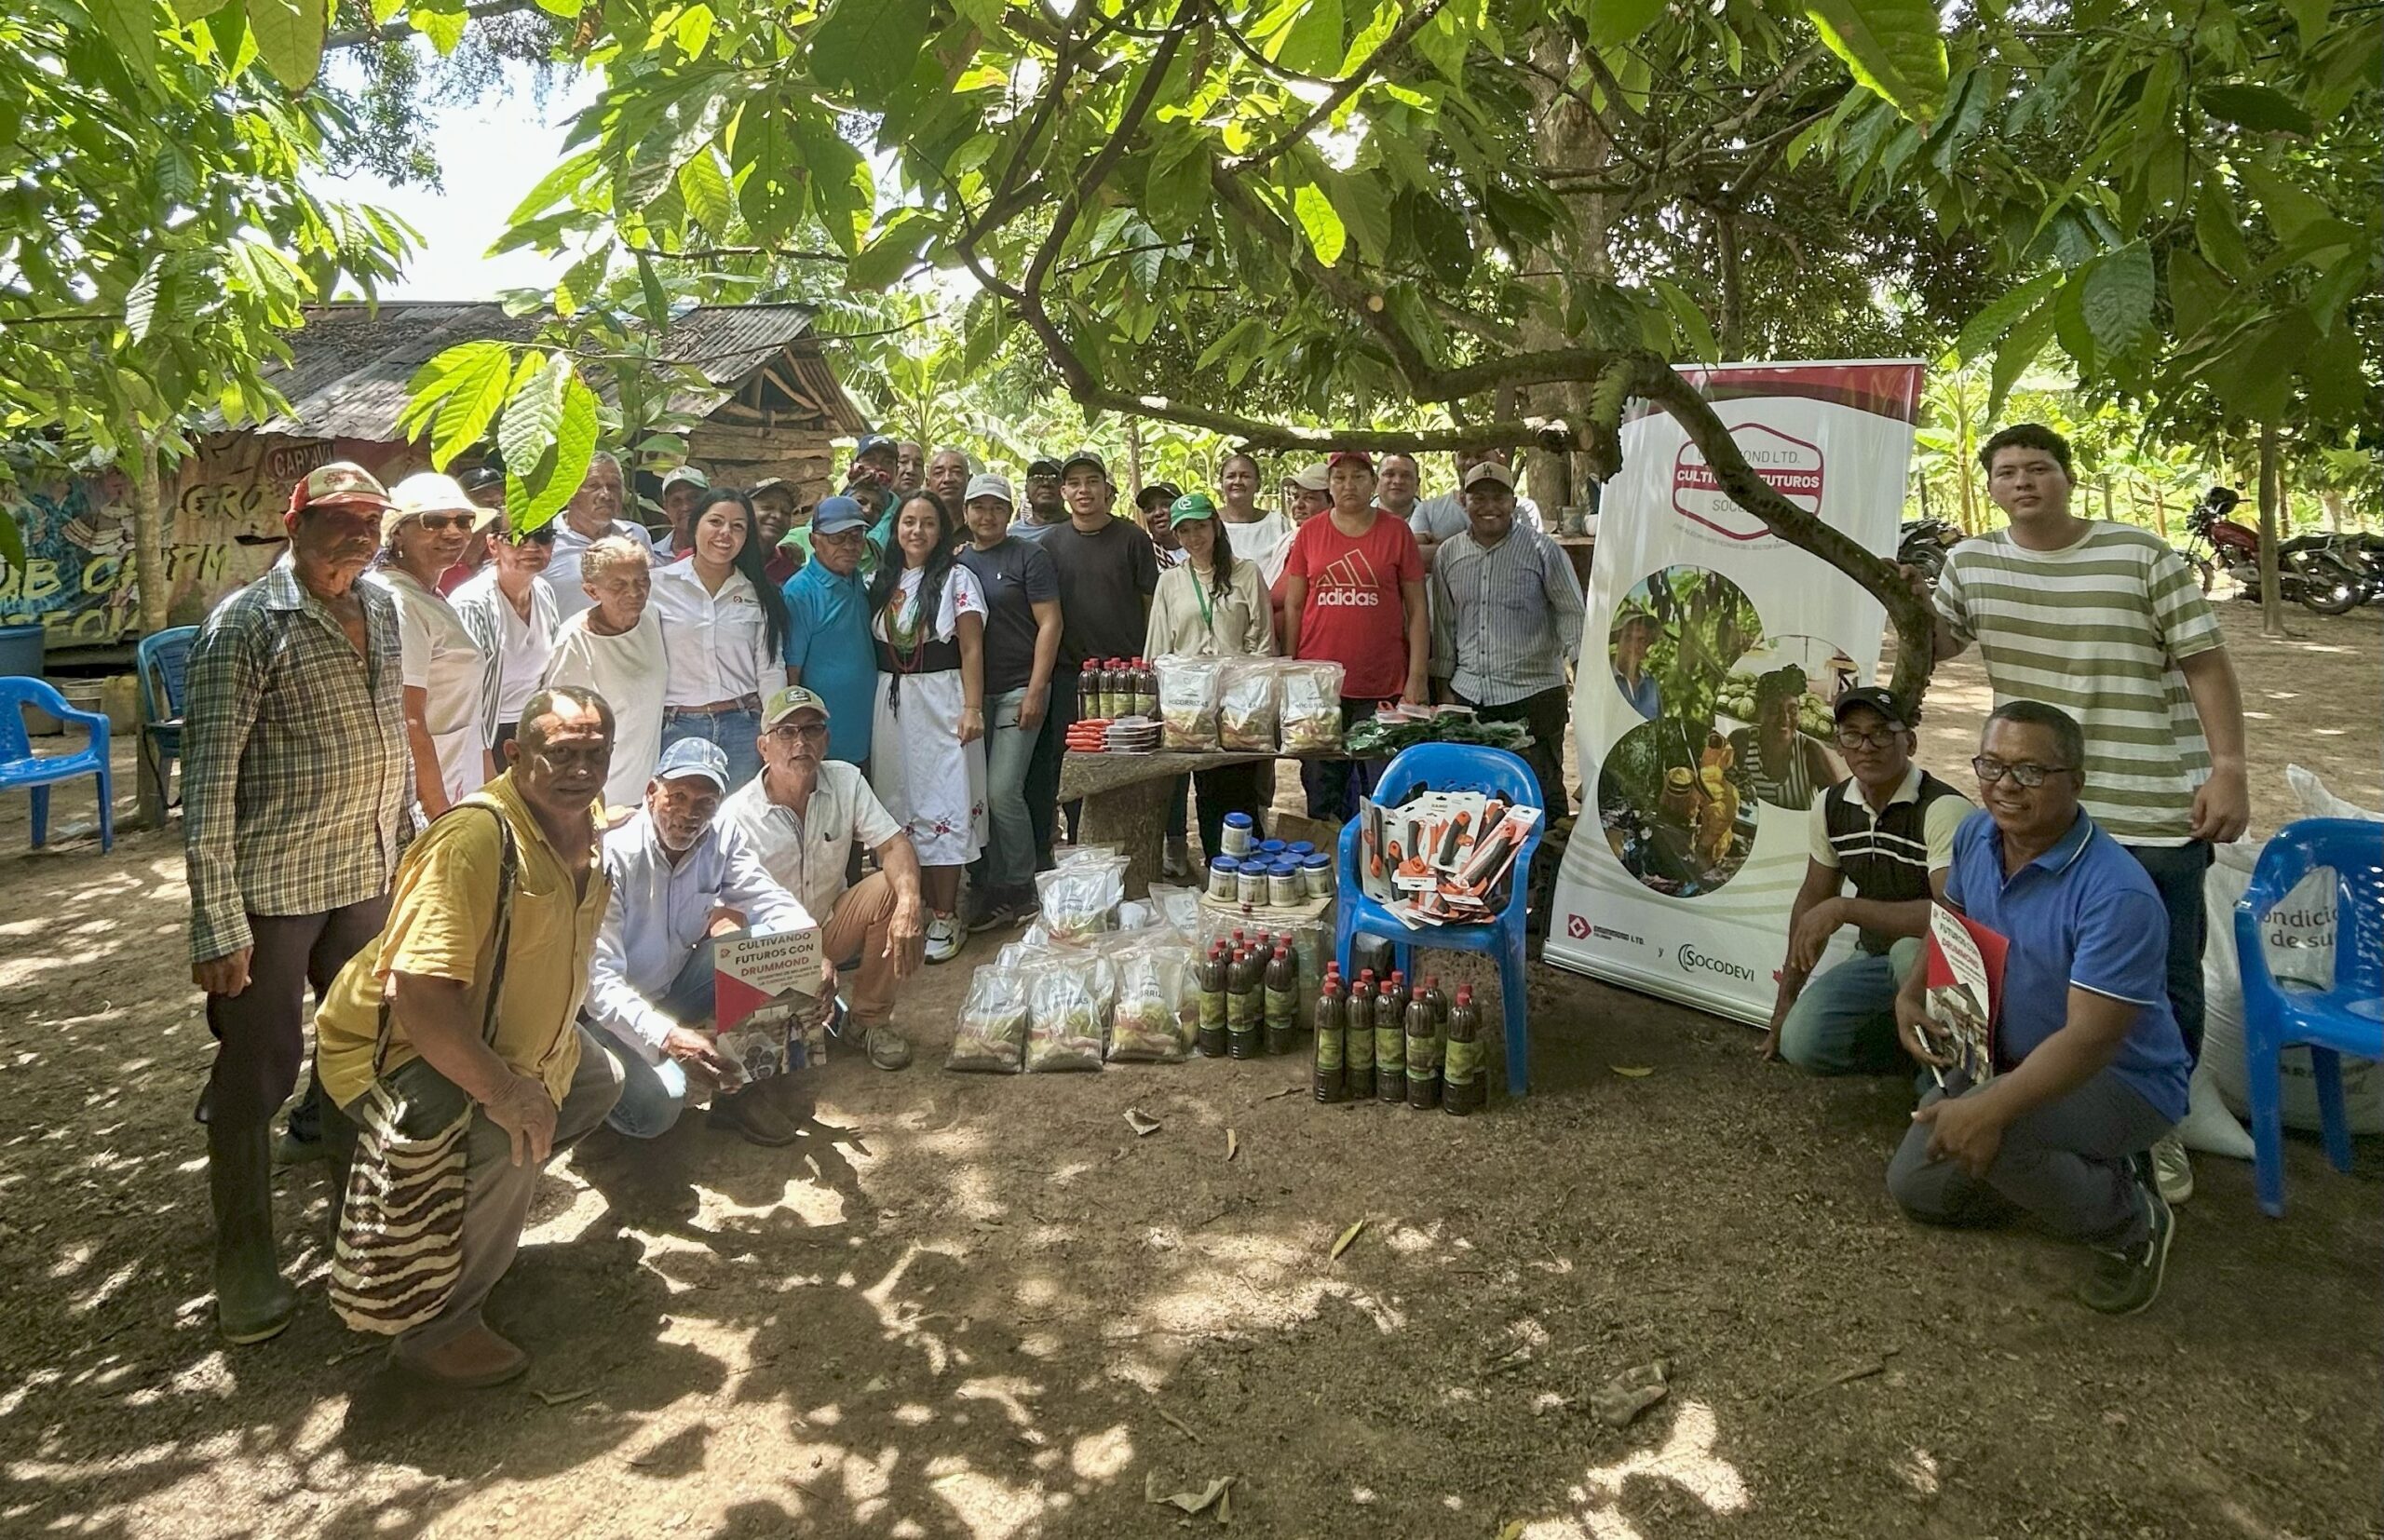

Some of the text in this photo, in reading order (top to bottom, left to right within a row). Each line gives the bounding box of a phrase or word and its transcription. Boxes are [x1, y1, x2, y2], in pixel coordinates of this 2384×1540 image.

[1773, 452, 1800, 464] LTD.
[1677, 469, 1717, 484] CULTI
[1318, 588, 1378, 606] adidas
[2262, 906, 2338, 927] ondici
[738, 932, 811, 952] CULTIVANDO
[2270, 929, 2335, 948] de su
[736, 943, 814, 965] FUTUROS CON
[741, 956, 809, 978] DRUMMOND
[1686, 950, 1755, 982] SOCODEVI
